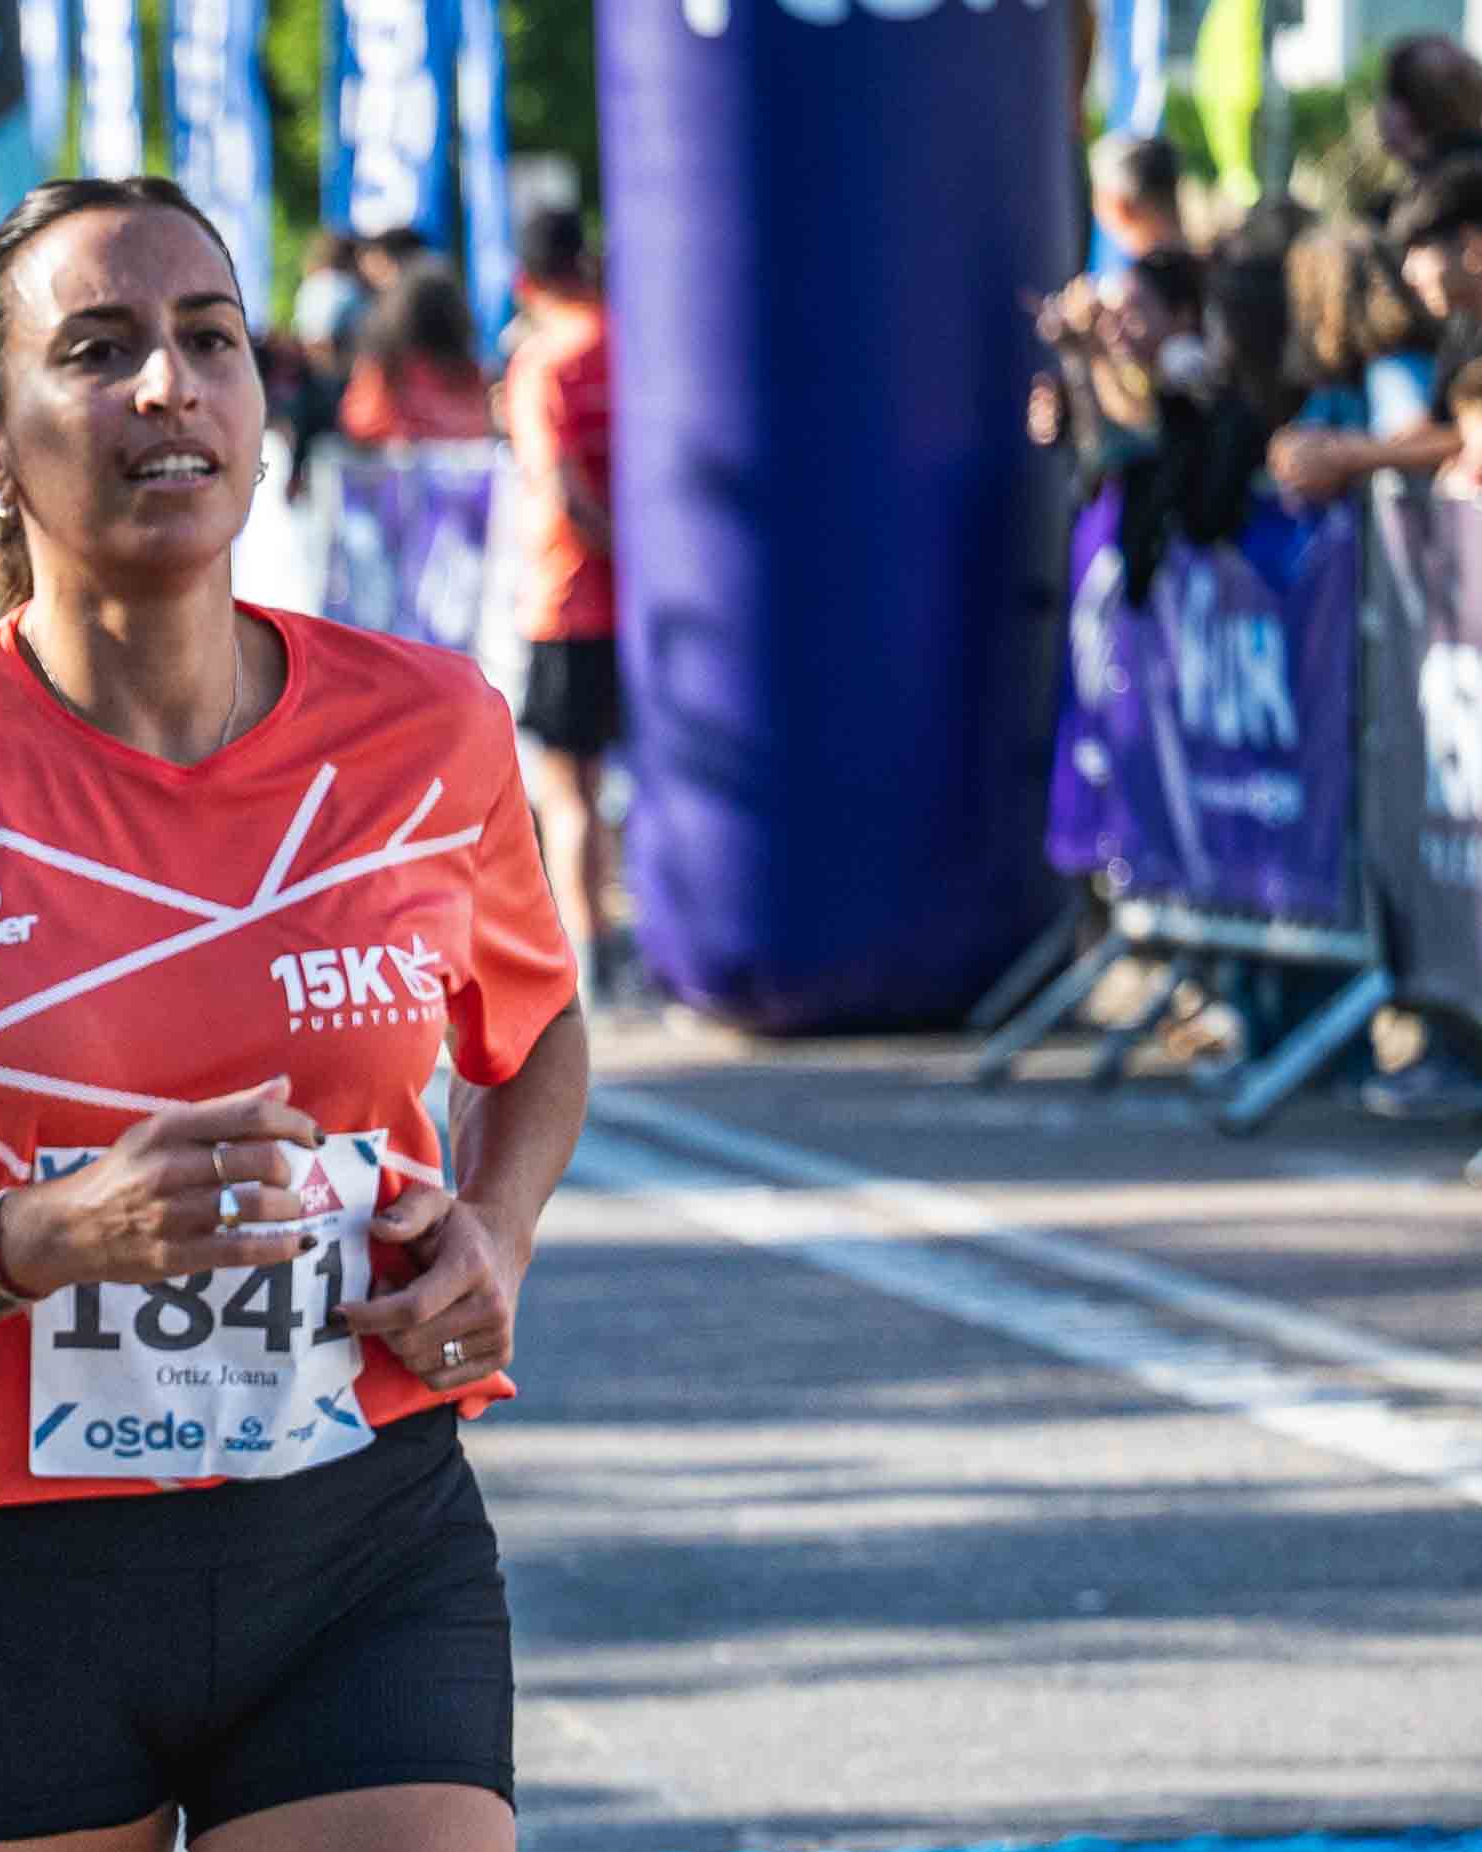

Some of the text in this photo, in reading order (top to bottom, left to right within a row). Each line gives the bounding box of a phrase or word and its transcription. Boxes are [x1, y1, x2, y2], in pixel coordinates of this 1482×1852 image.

[269, 945, 396, 1013] 15K
[53, 1240, 353, 1353] 1841
[155, 1363, 280, 1387] Ortiz Joana
[84, 1409, 205, 1453] osde
